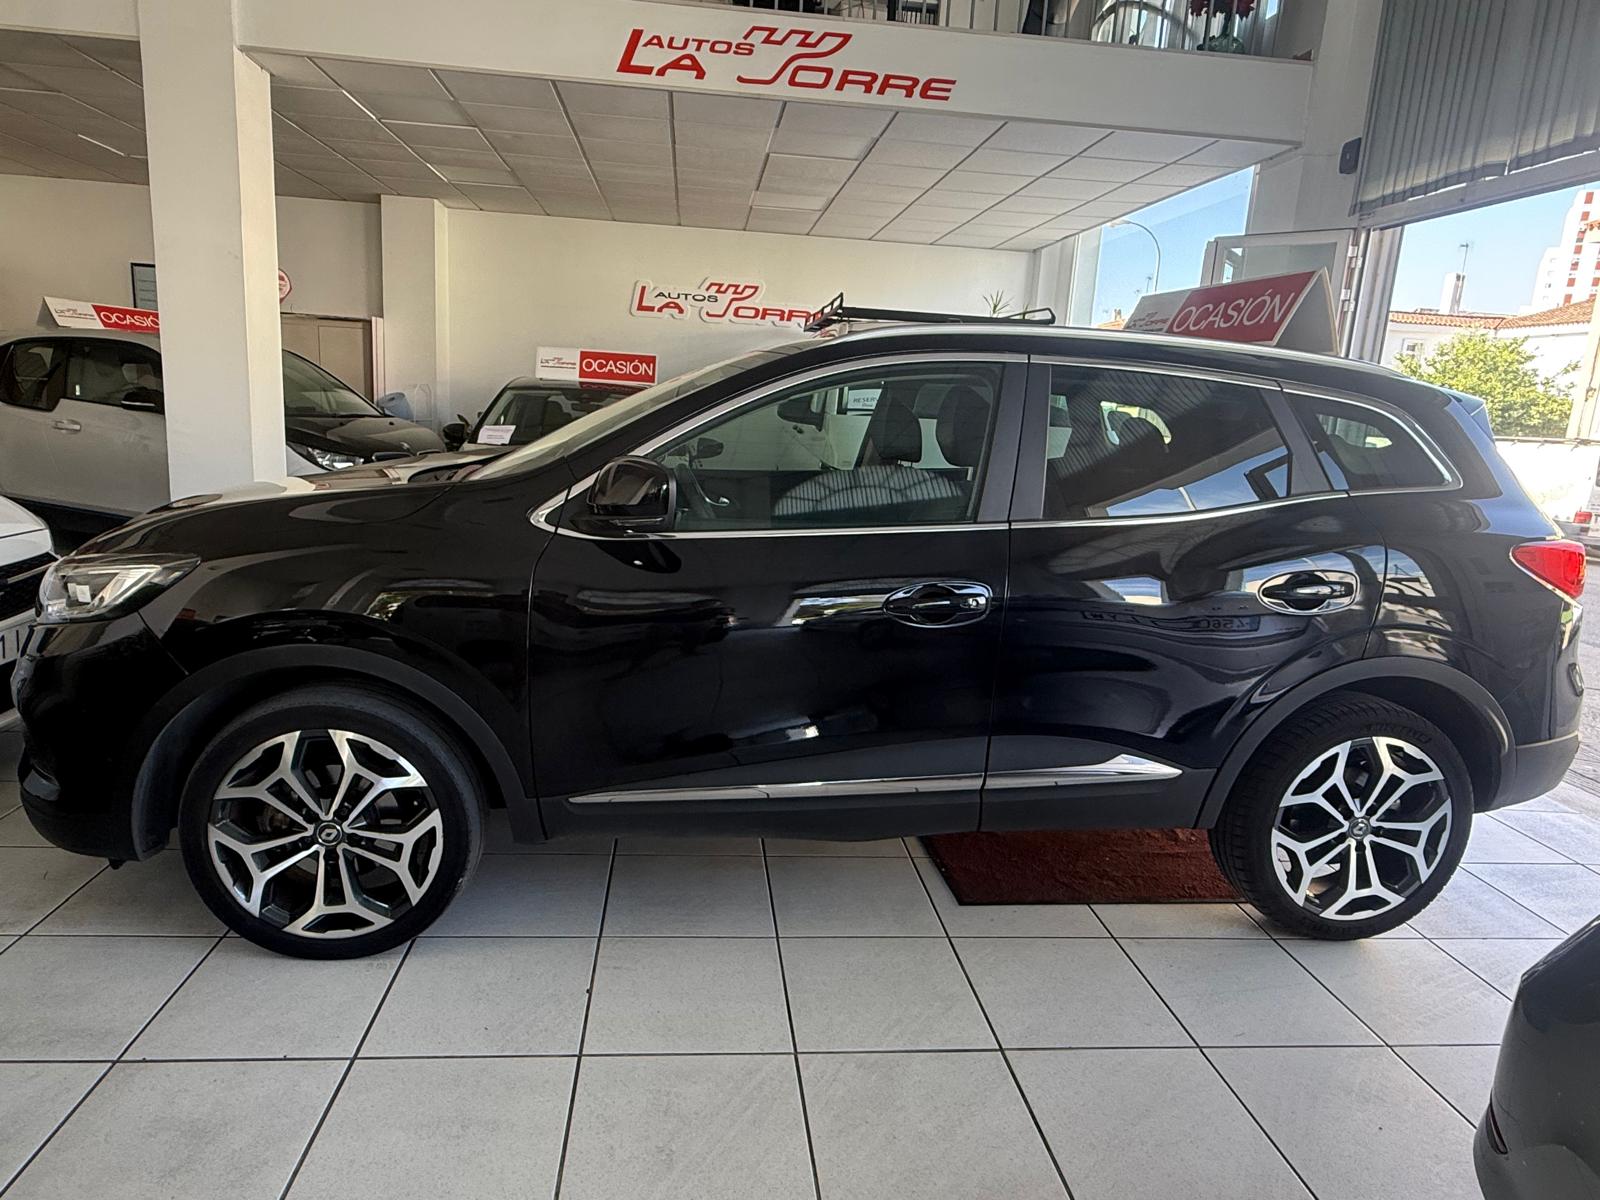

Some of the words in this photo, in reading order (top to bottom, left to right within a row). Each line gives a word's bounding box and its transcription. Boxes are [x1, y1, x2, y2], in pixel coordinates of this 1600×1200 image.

[642, 34, 755, 56] AUTOS
[616, 28, 706, 80] LA
[737, 25, 957, 101] TORRE
[636, 285, 684, 314] LA
[654, 291, 718, 303] AUTOS
[100, 311, 160, 328] OCASIÓ
[1173, 289, 1295, 332] OCASIÓN
[582, 357, 653, 376] OCASIÓN
